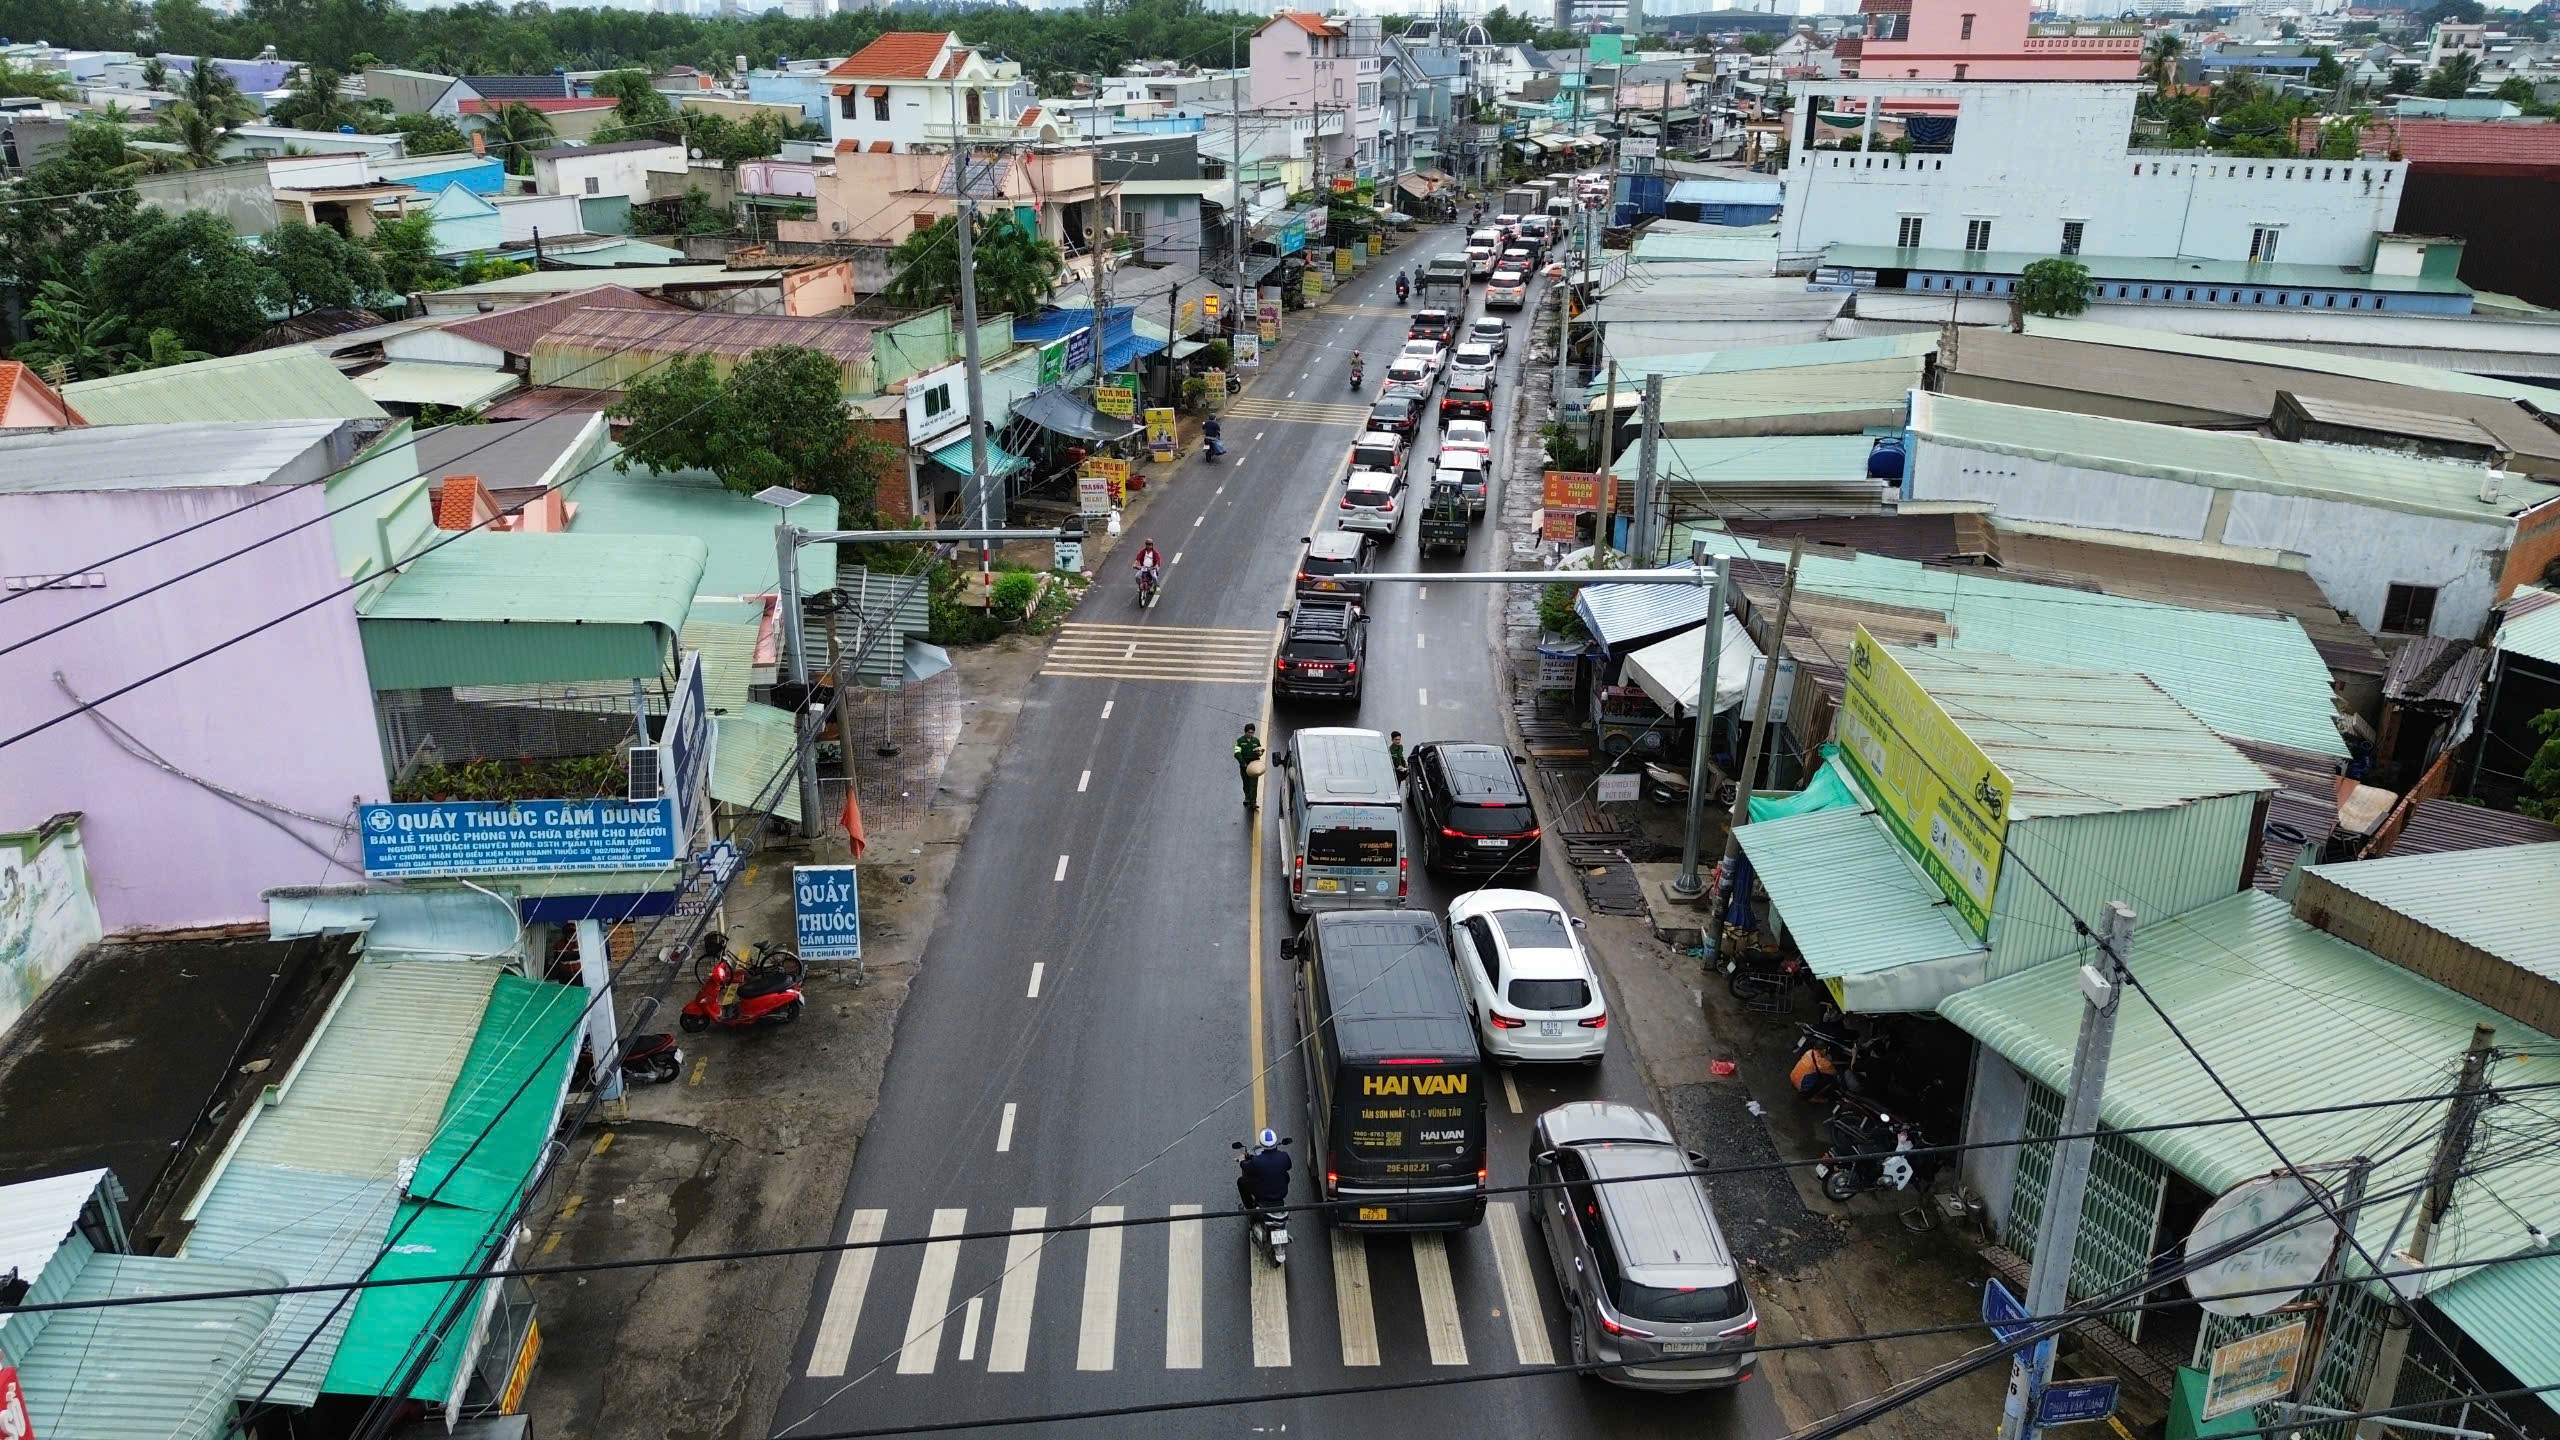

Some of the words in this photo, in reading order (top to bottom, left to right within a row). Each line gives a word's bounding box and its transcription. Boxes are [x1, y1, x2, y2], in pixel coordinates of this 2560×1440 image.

[398, 807, 458, 831] QUẦY
[464, 805, 537, 828] THUỐC
[602, 808, 661, 825] DUNG
[370, 833, 397, 845] BÁN
[400, 831, 416, 844] LẺ
[418, 831, 460, 843] THUỐC
[463, 830, 507, 842] PHÒNG
[510, 829, 527, 840] VÀ
[529, 828, 563, 840] CHỮA
[566, 828, 599, 840] BỆNH
[602, 828, 626, 838] CHO
[629, 827, 667, 837] NGƯỜI
[387, 844, 417, 853] NGƯỜI
[419, 844, 438, 853] PHỤ
[440, 842, 471, 851] TRÁCH
[472, 841, 509, 850] CHUYÊN
[511, 840, 536, 848] MÔN:
[589, 838, 603, 847] THỊ
[399, 852, 427, 861] CHỨNG
[428, 851, 451, 860] NHẬN
[485, 849, 504, 858] KIỆN
[505, 849, 525, 857] KINH
[526, 848, 553, 856] DOANH
[799, 875, 851, 907] QUẦY
[799, 904, 856, 931] THUỐC
[827, 934, 857, 945] DUNG
[1363, 1075, 1409, 1096] HAI
[1412, 1074, 1468, 1095] VAN
[1361, 1108, 1375, 1119] TÂN
[1375, 1108, 1389, 1119] SƠN
[1389, 1106, 1406, 1119] NHẤT
[1428, 1108, 1447, 1118] VŨNG
[1420, 1131, 1440, 1140] HAI
[1441, 1130, 1465, 1139] VAN
[2010, 1383, 2018, 1397] 6
